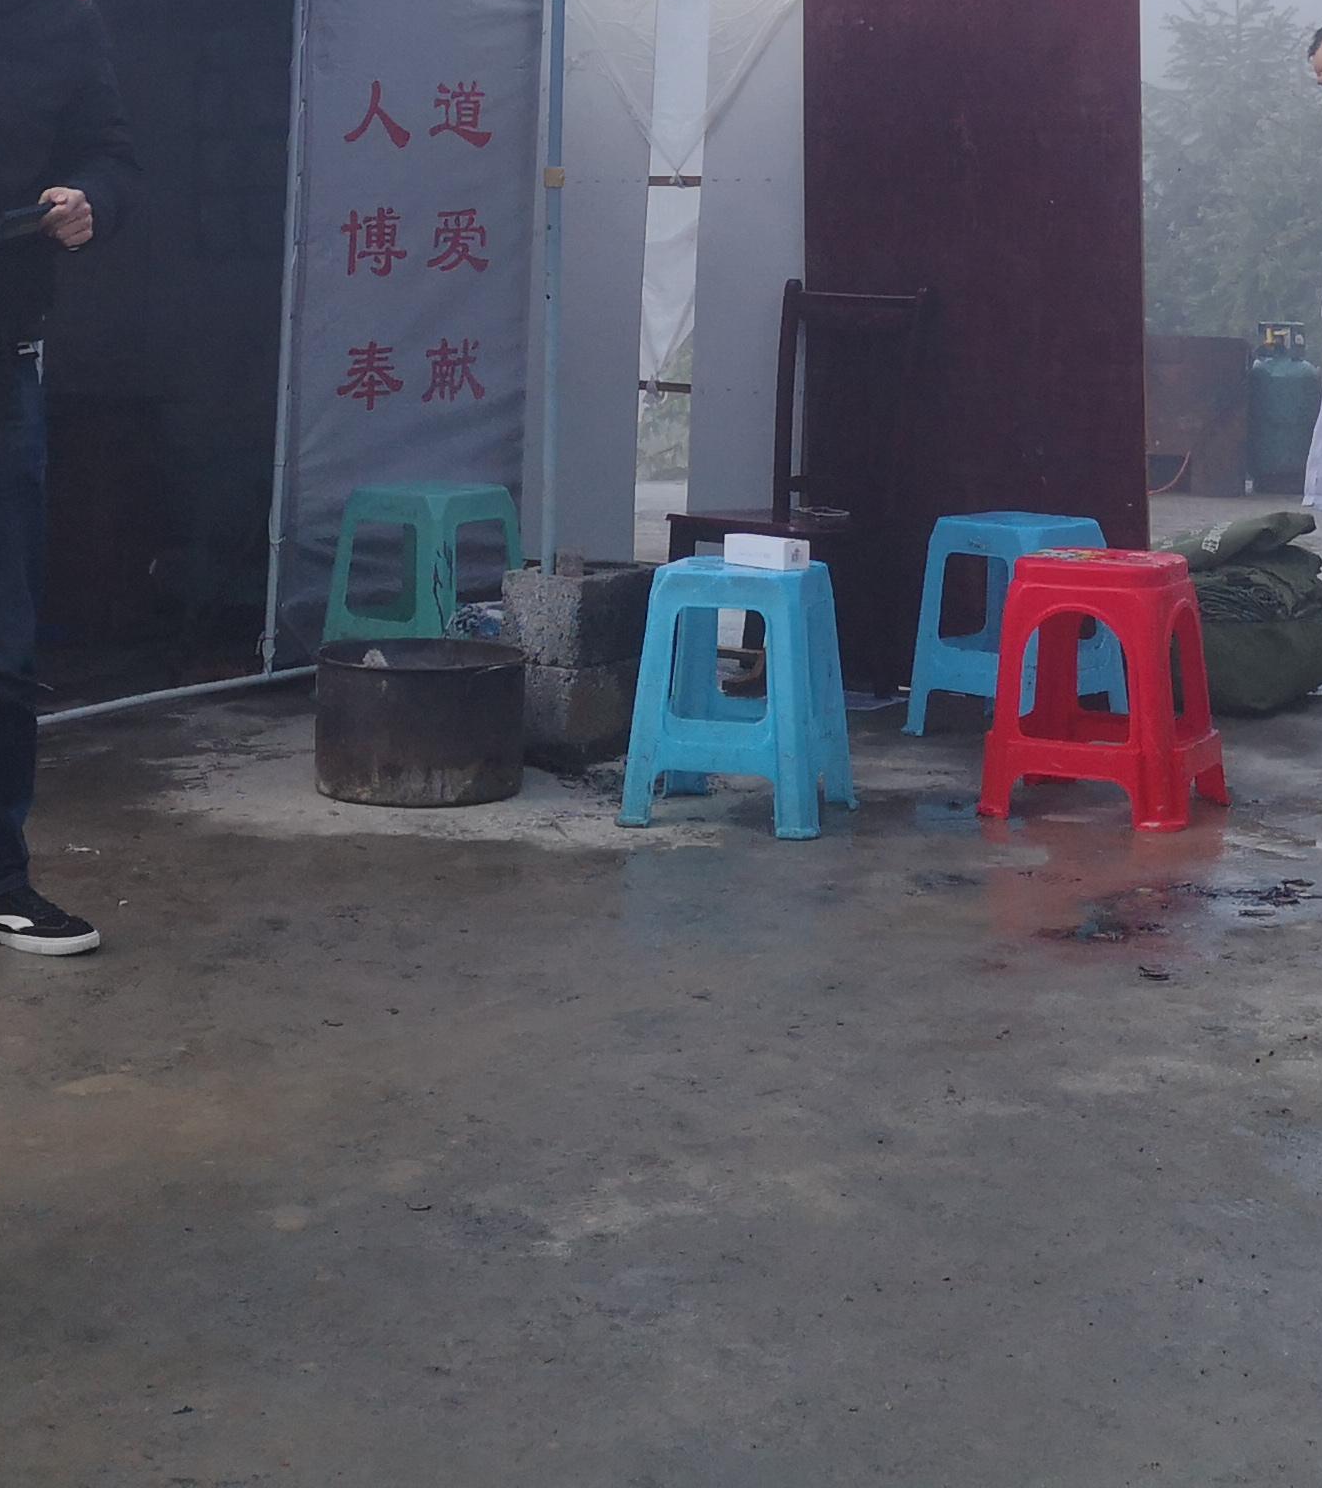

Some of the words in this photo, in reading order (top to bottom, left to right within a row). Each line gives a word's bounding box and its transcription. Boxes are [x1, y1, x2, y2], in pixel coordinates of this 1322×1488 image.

[343, 80, 492, 148] 人道
[340, 207, 490, 276] 博爱
[337, 337, 485, 411] 奉献
